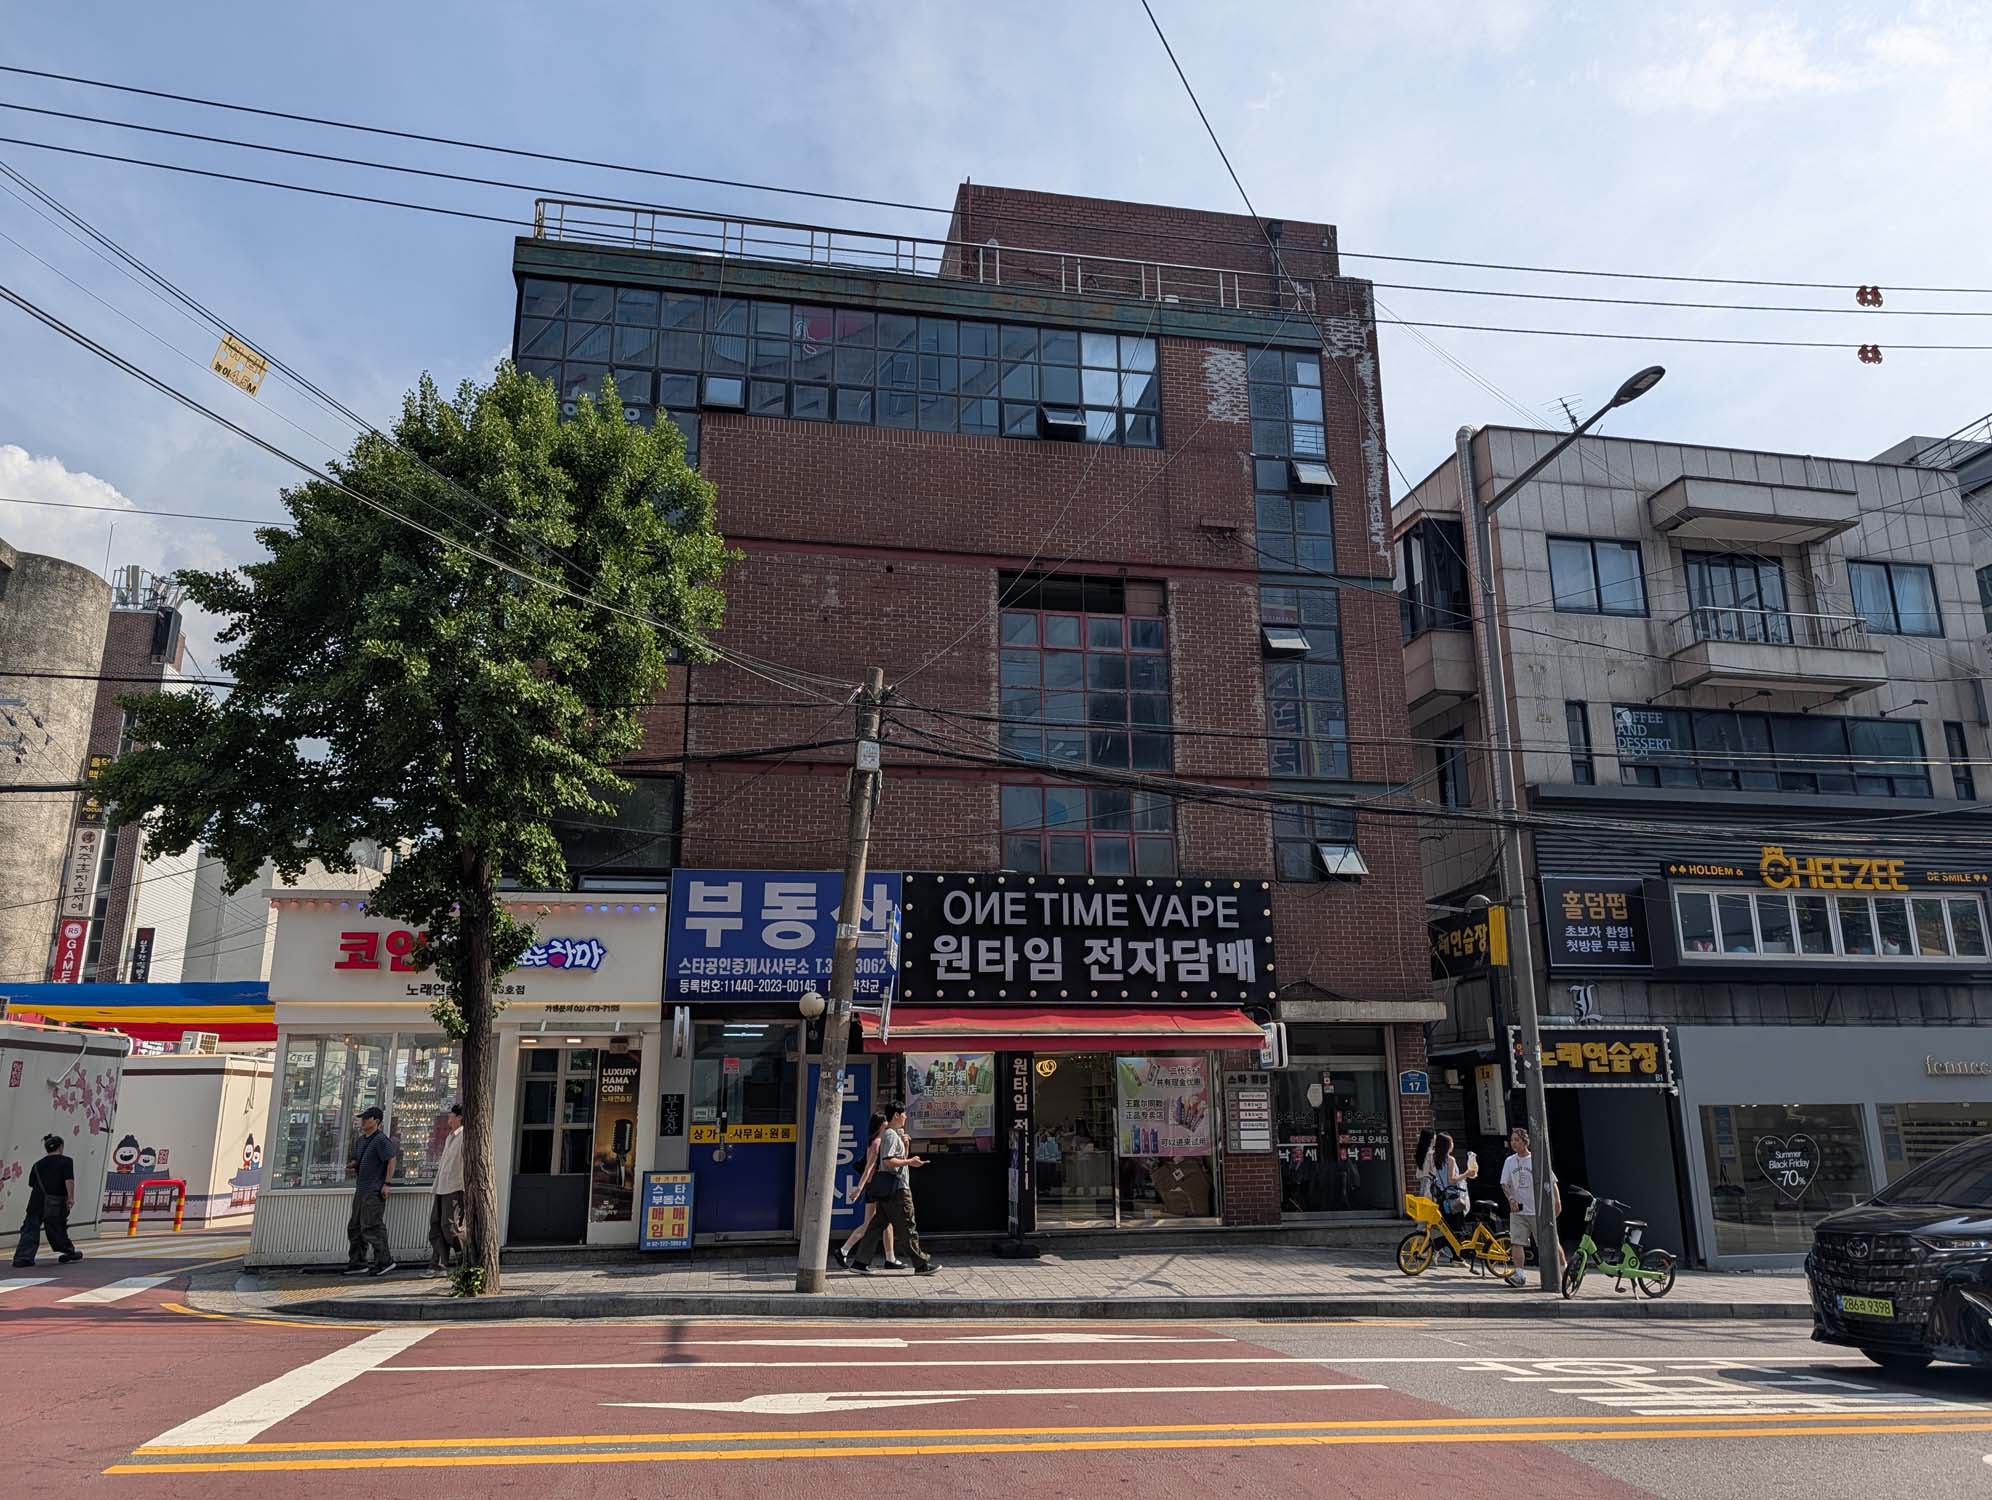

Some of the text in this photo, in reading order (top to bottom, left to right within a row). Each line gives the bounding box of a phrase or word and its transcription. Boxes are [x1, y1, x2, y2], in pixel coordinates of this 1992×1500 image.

[1615, 711, 1664, 724] CFFEE
[1616, 724, 1648, 736] AND
[1617, 736, 1672, 750] DESSERT
[1688, 864, 1734, 877] HOLDEM
[1760, 851, 1909, 891] CHEEZEE
[1942, 872, 1972, 883] SMILE
[1034, 891, 1129, 928] TIME
[1134, 893, 1240, 929] VAPE
[1561, 890, 1629, 921] 홀덤펍
[685, 880, 893, 950] 부동산
[1564, 925, 1635, 939] 초보자 환영!
[1433, 923, 1488, 958] 래연습장
[1565, 939, 1636, 953] 첫방문 무료!
[929, 935, 1063, 982] 원타임
[1082, 936, 1257, 983] 전자담배
[678, 957, 810, 976] 스타공인중개사사무소
[602, 1068, 638, 1076] LUXURY
[1655, 1074, 1664, 1082] B1
[602, 1076, 630, 1085] HAMA
[1013, 1058, 1028, 1111] 원타임
[1409, 1081, 1421, 1092] 17
[601, 1085, 625, 1093] COIN
[1367, 1135, 1390, 1144] 오세요
[1775, 1150, 1802, 1159] Summer
[1768, 1159, 1810, 1169] Black Friday
[1867, 1300, 1891, 1315] 9398
